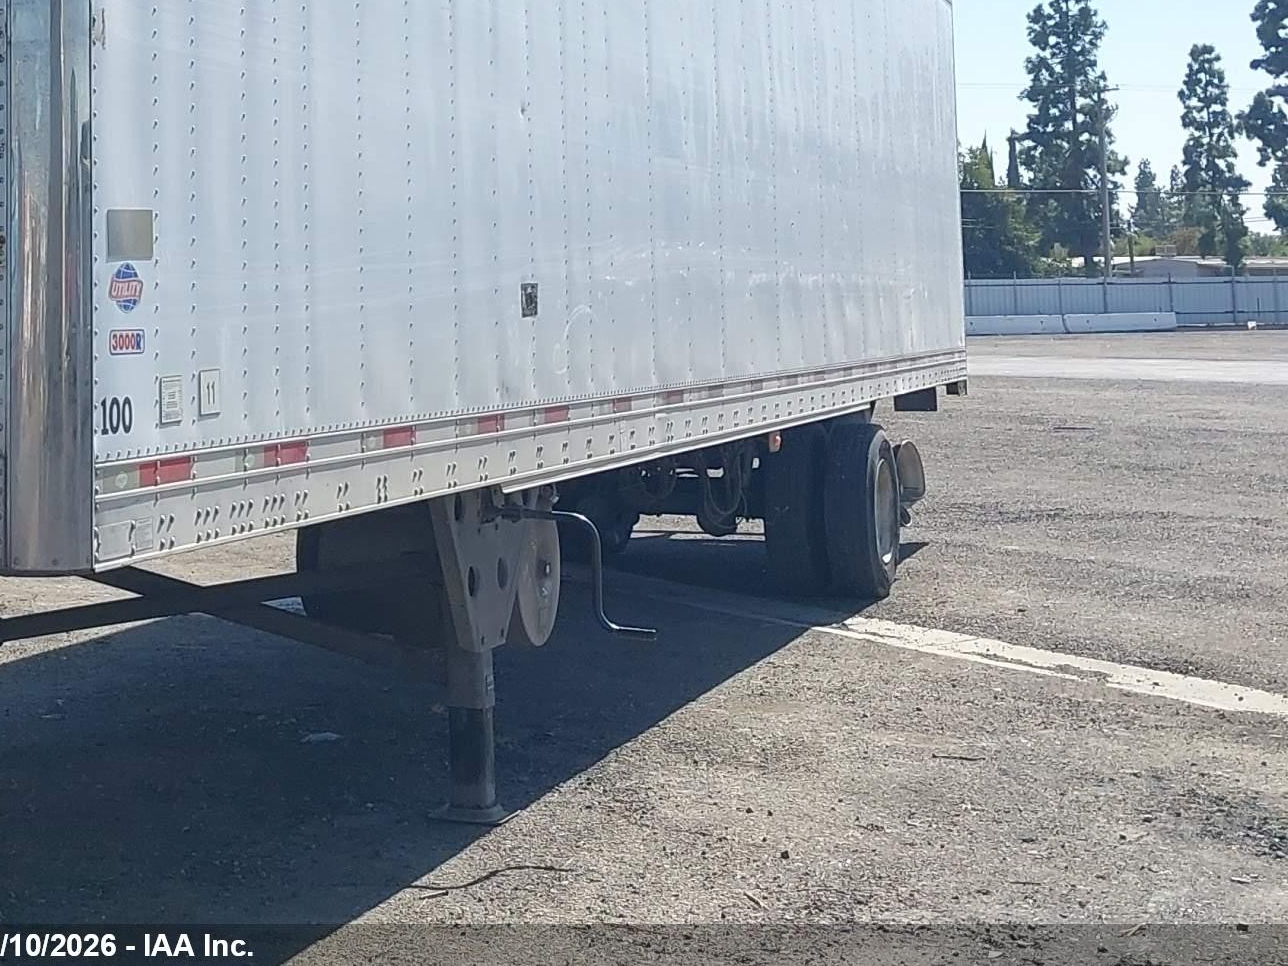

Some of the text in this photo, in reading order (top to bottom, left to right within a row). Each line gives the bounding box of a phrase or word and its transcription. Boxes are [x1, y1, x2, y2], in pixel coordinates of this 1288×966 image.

[112, 282, 142, 298] UTILITY
[112, 333, 143, 351] 3000R
[100, 396, 133, 435] 100
